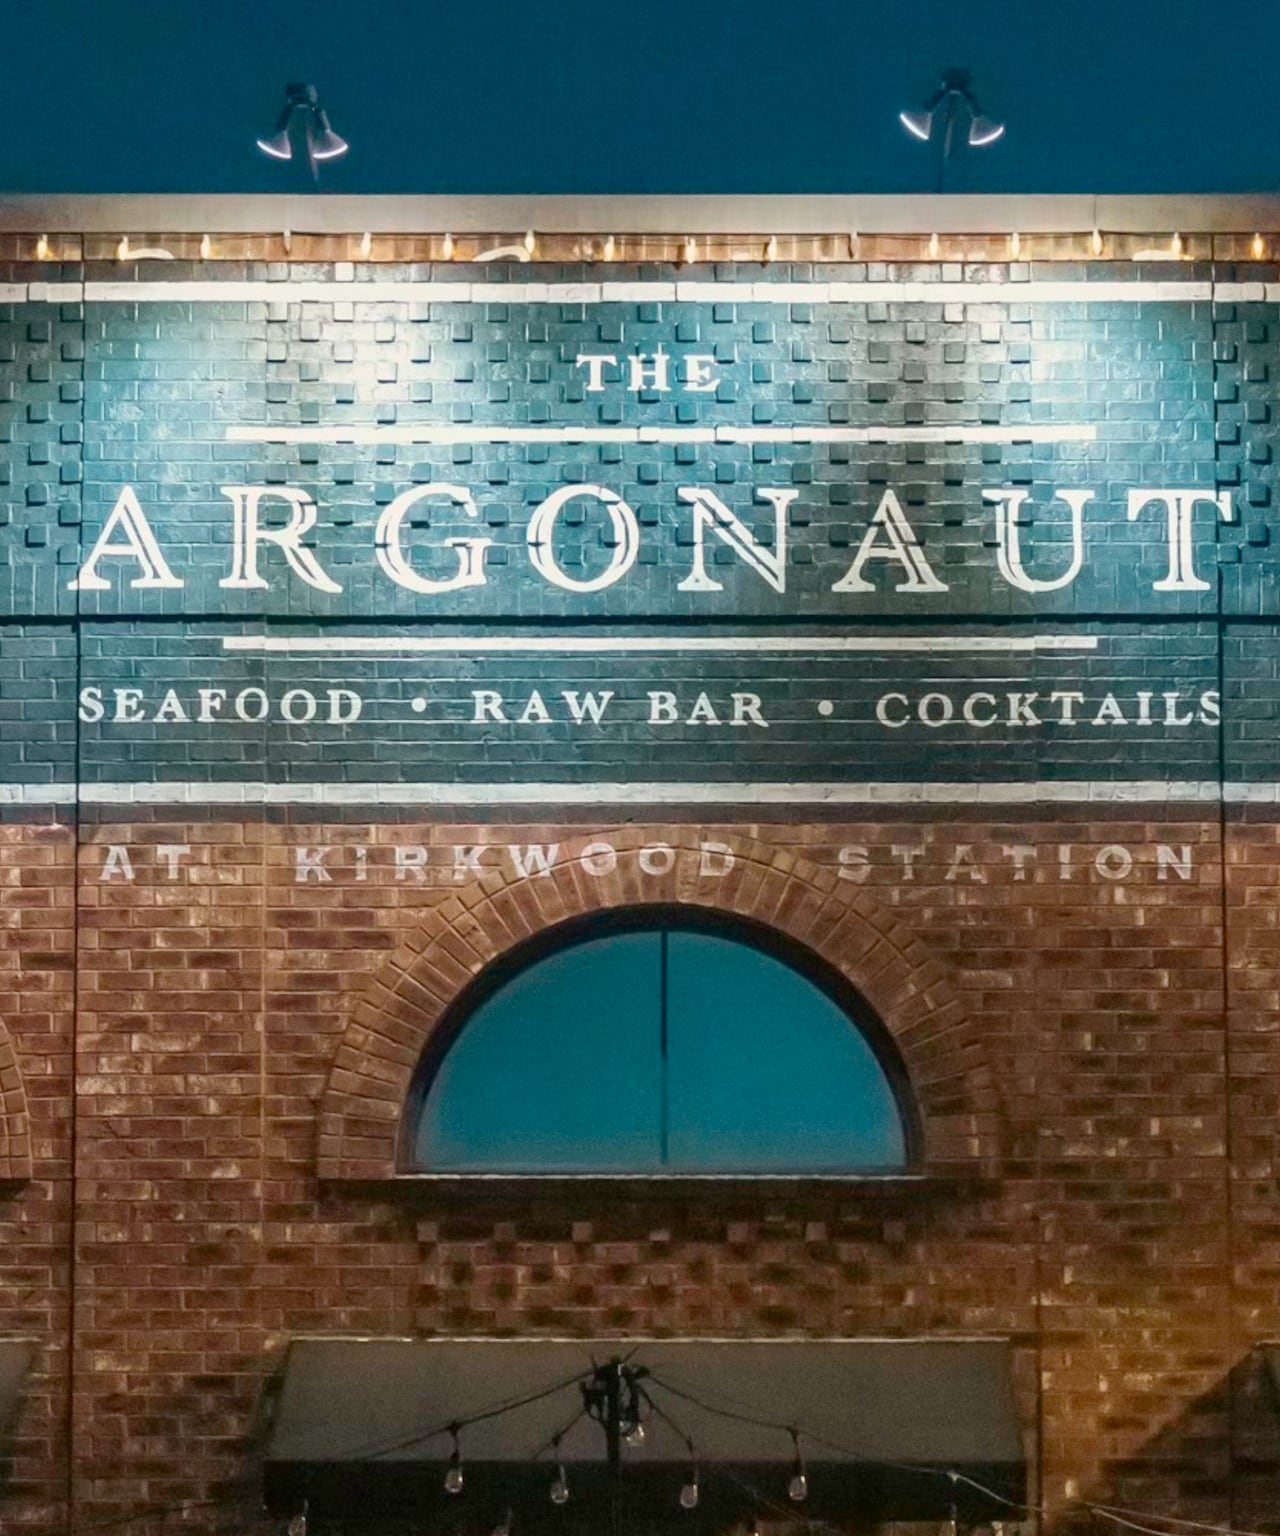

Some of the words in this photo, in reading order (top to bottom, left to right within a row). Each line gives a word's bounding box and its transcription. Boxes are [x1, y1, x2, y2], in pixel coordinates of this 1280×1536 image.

[576, 350, 721, 392] THE
[68, 483, 1232, 594] ARGONAUT
[78, 687, 363, 725] SEAFOOD
[471, 689, 615, 726] RAW
[646, 690, 769, 728] BAR
[875, 691, 1221, 728] COCKTAILS
[100, 844, 192, 881] AT
[294, 841, 736, 882] KIRKWOOD
[837, 843, 1193, 881] STATION
